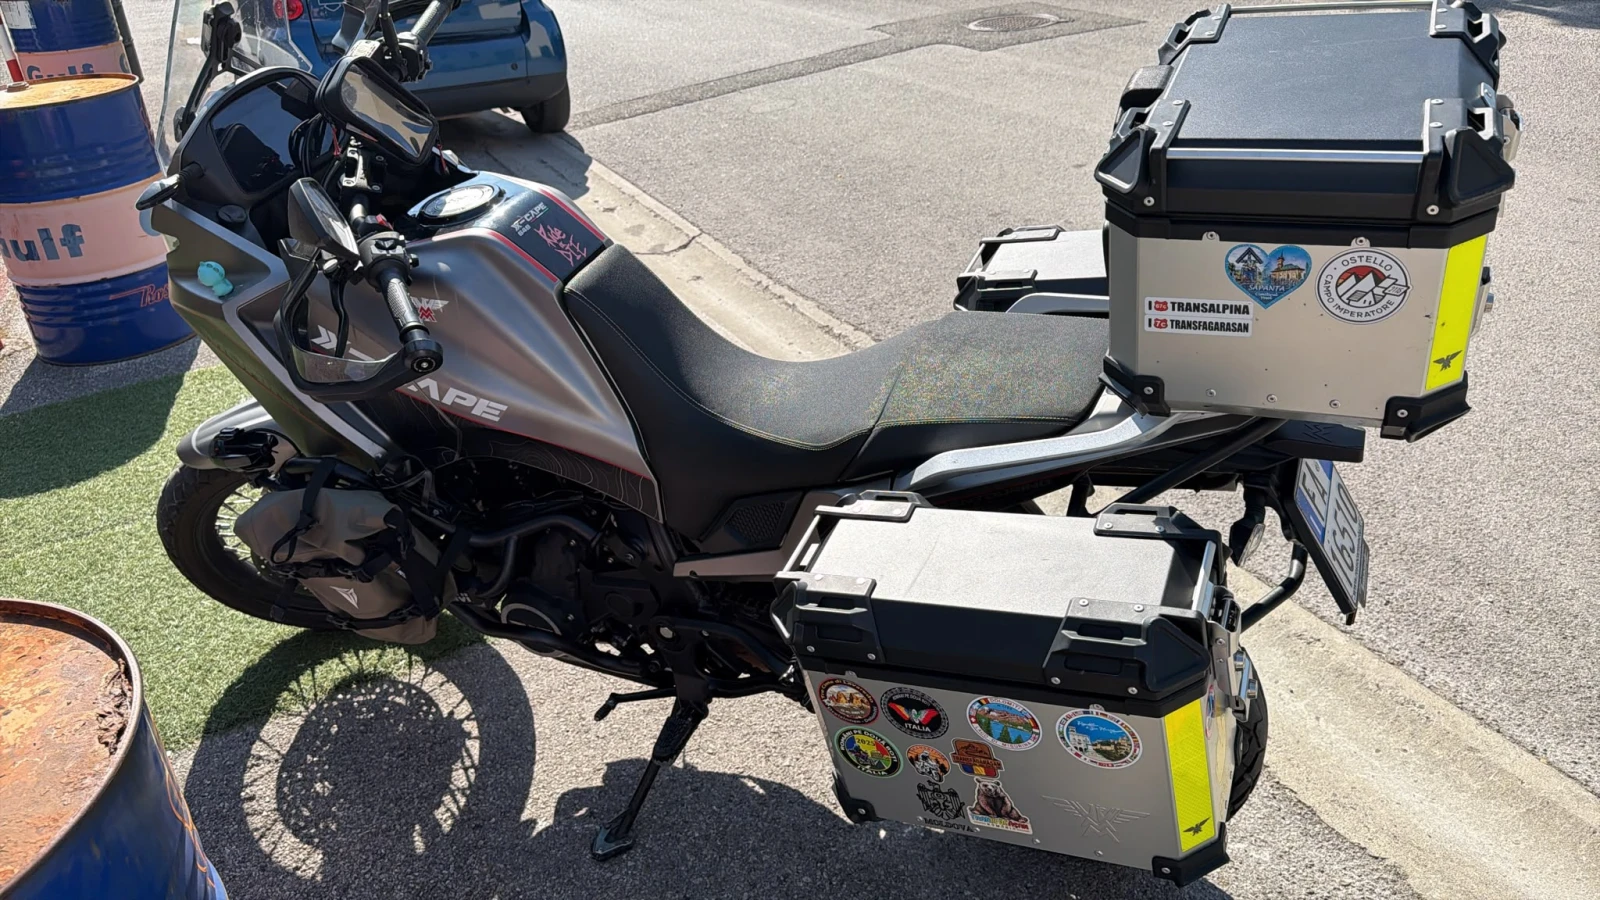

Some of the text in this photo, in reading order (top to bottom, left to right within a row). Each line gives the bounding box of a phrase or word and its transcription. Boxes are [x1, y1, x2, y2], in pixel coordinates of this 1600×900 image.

[1341, 255, 1393, 271] OSTELLO
[1323, 274, 1395, 318] CAMPO IMPERATORE
[1170, 301, 1250, 315] TRANSALPINA
[1169, 319, 1249, 333] TRANSFAGARASAN
[904, 722, 931, 733] ITALIA
[856, 738, 875, 746] 2025
[857, 765, 888, 775] ITALIA
